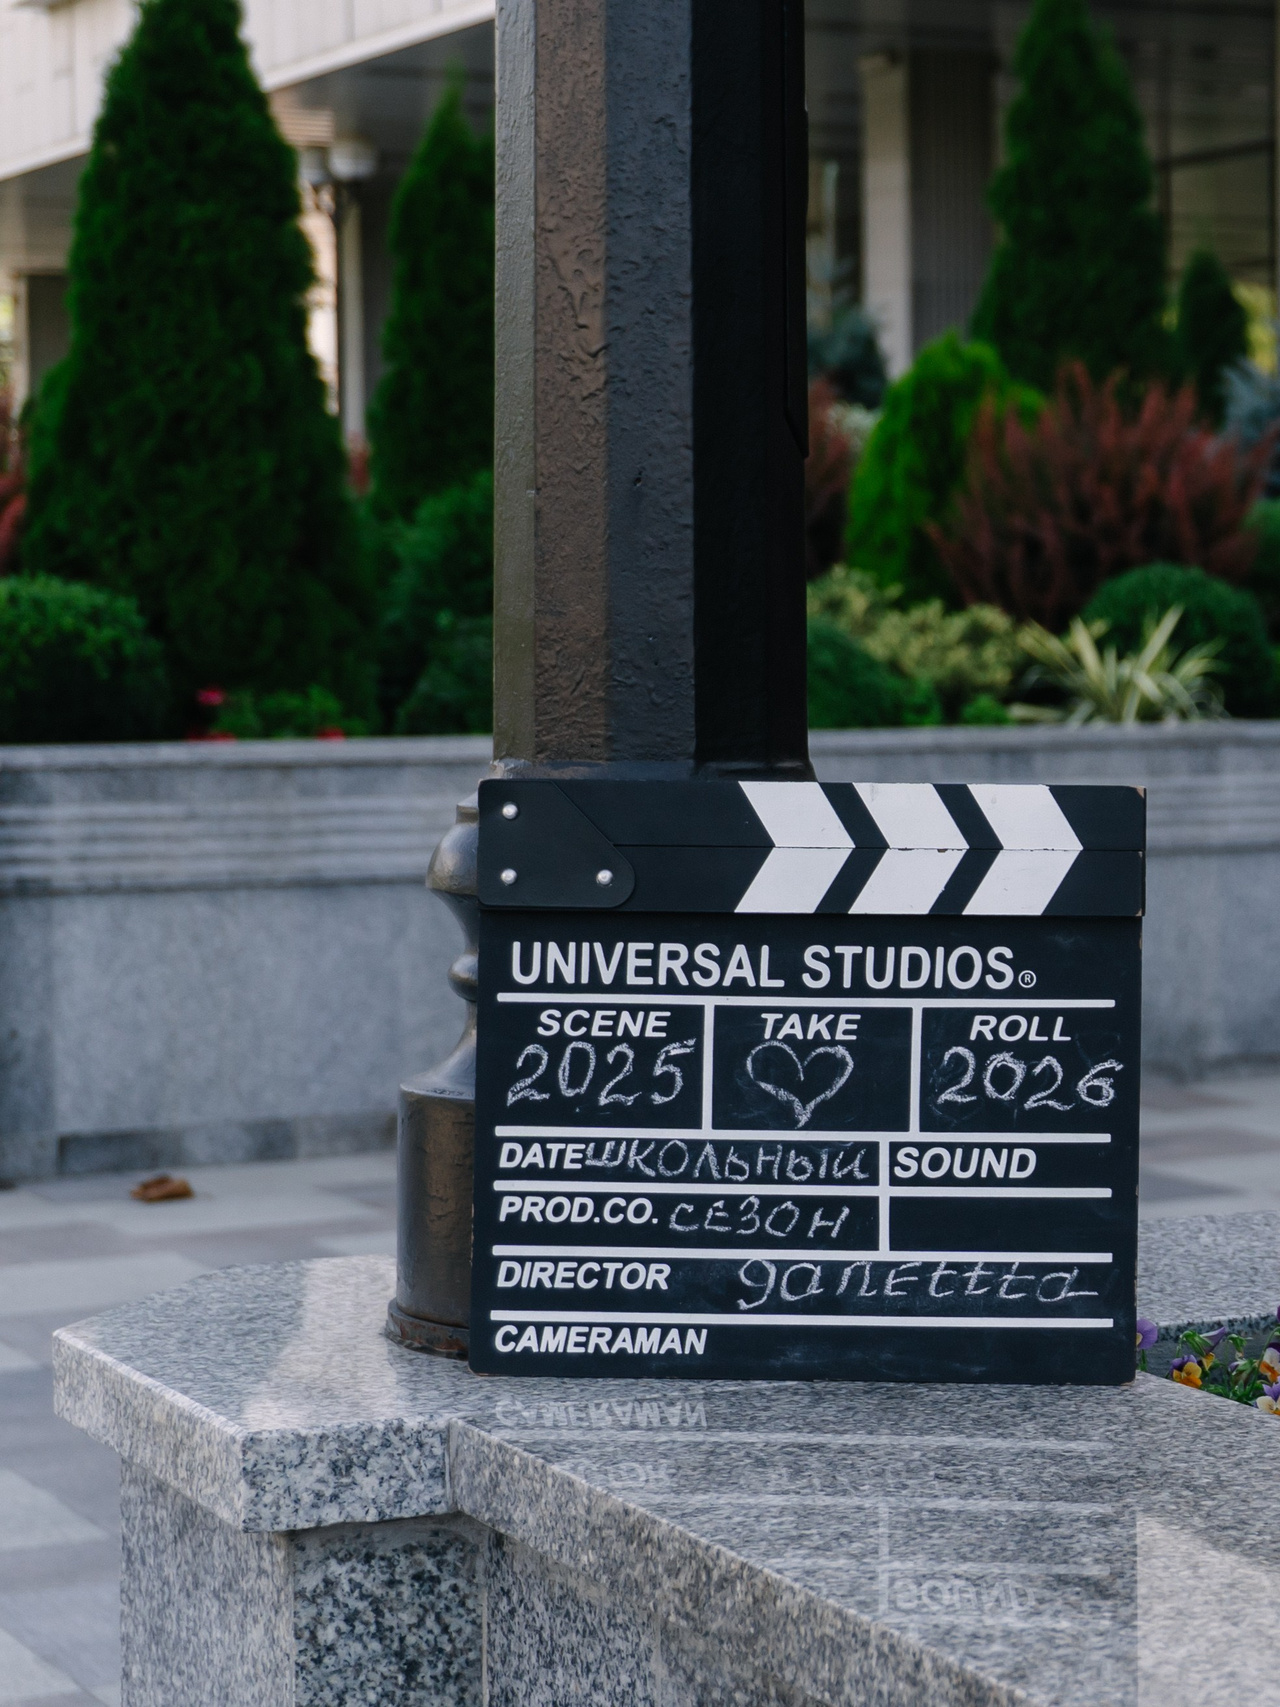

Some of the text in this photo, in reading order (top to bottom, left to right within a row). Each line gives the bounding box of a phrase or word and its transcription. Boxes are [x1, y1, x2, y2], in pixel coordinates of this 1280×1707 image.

[512, 941, 785, 987] UNIVERSAL
[537, 1009, 671, 1037] SCENE
[760, 1013, 861, 1040] TAKE
[969, 1015, 1072, 1042] ROLL
[507, 1037, 697, 1107] 2025
[936, 1045, 1124, 1111] 2026
[499, 1142, 584, 1170] DATE
[894, 1147, 1036, 1179] SOUND
[499, 1196, 659, 1224] PROD.CO.
[497, 1261, 671, 1290] DIRECTOR
[494, 1325, 708, 1355] CAMERAMAN
